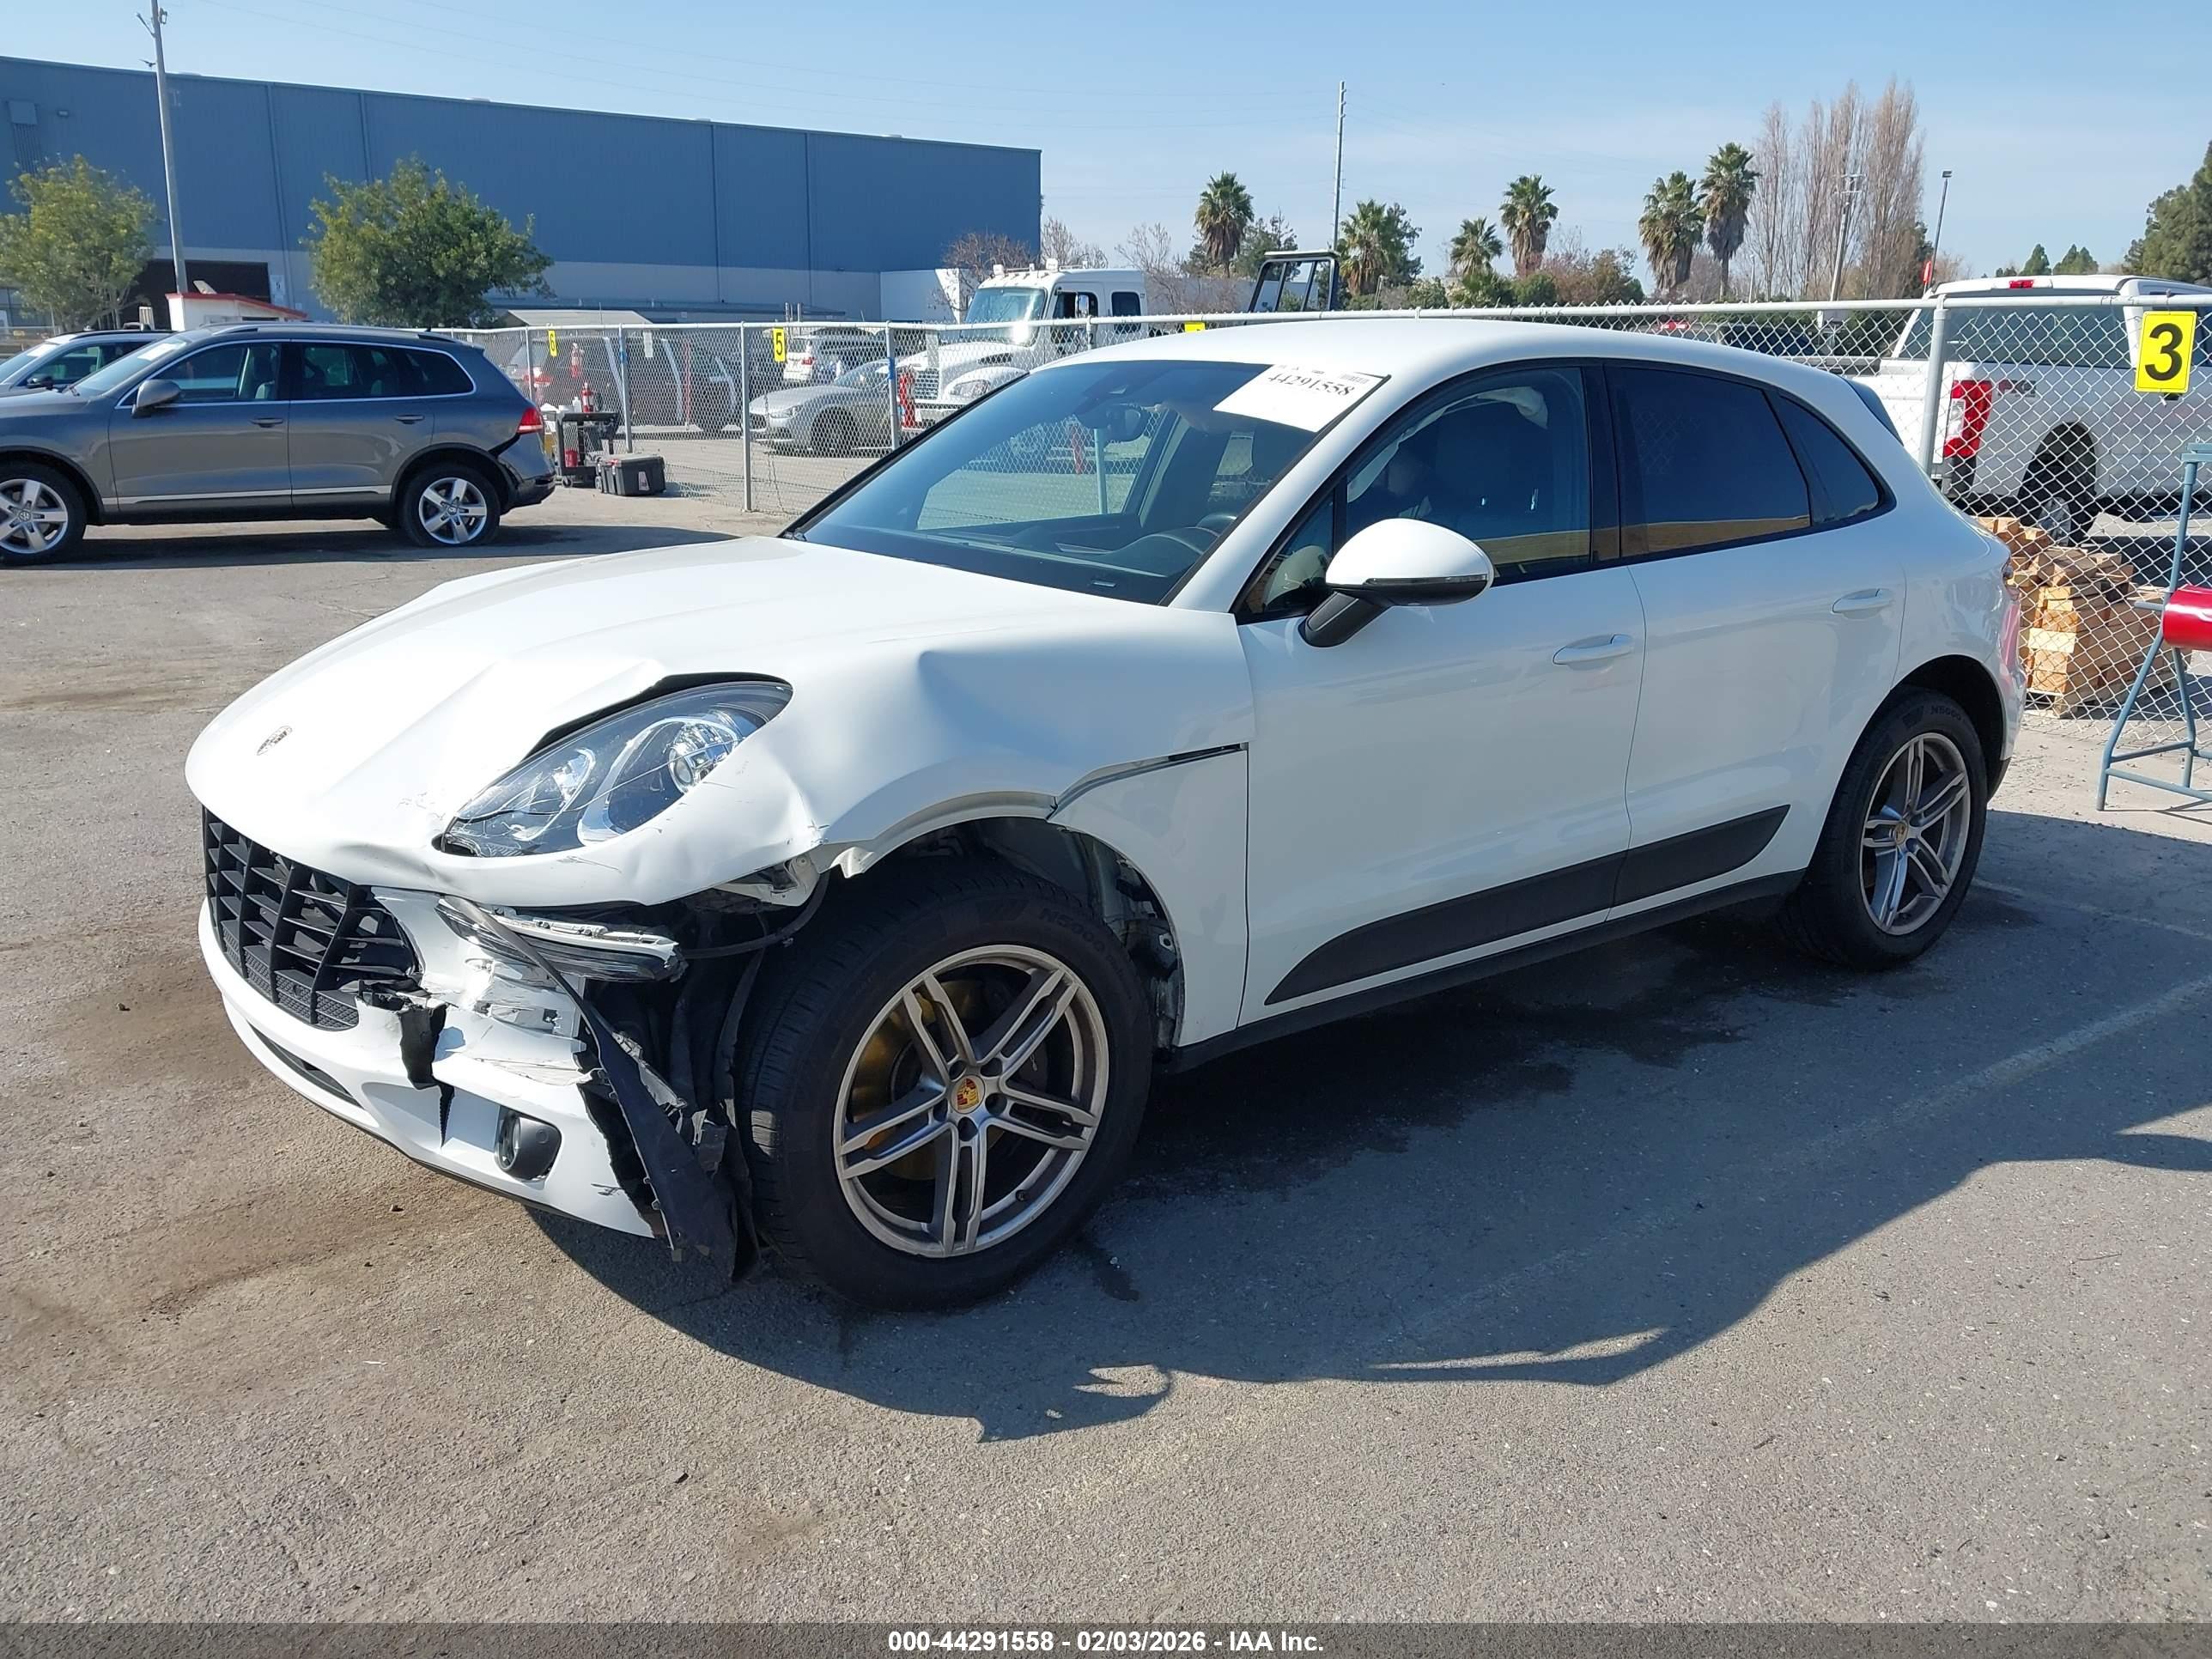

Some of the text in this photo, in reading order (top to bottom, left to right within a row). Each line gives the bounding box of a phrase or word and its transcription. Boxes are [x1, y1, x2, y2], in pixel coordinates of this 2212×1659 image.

[550, 333, 556, 352] 6
[775, 331, 783, 356] 5
[2145, 323, 2184, 381] 3
[1267, 373, 1355, 396] 44291558
